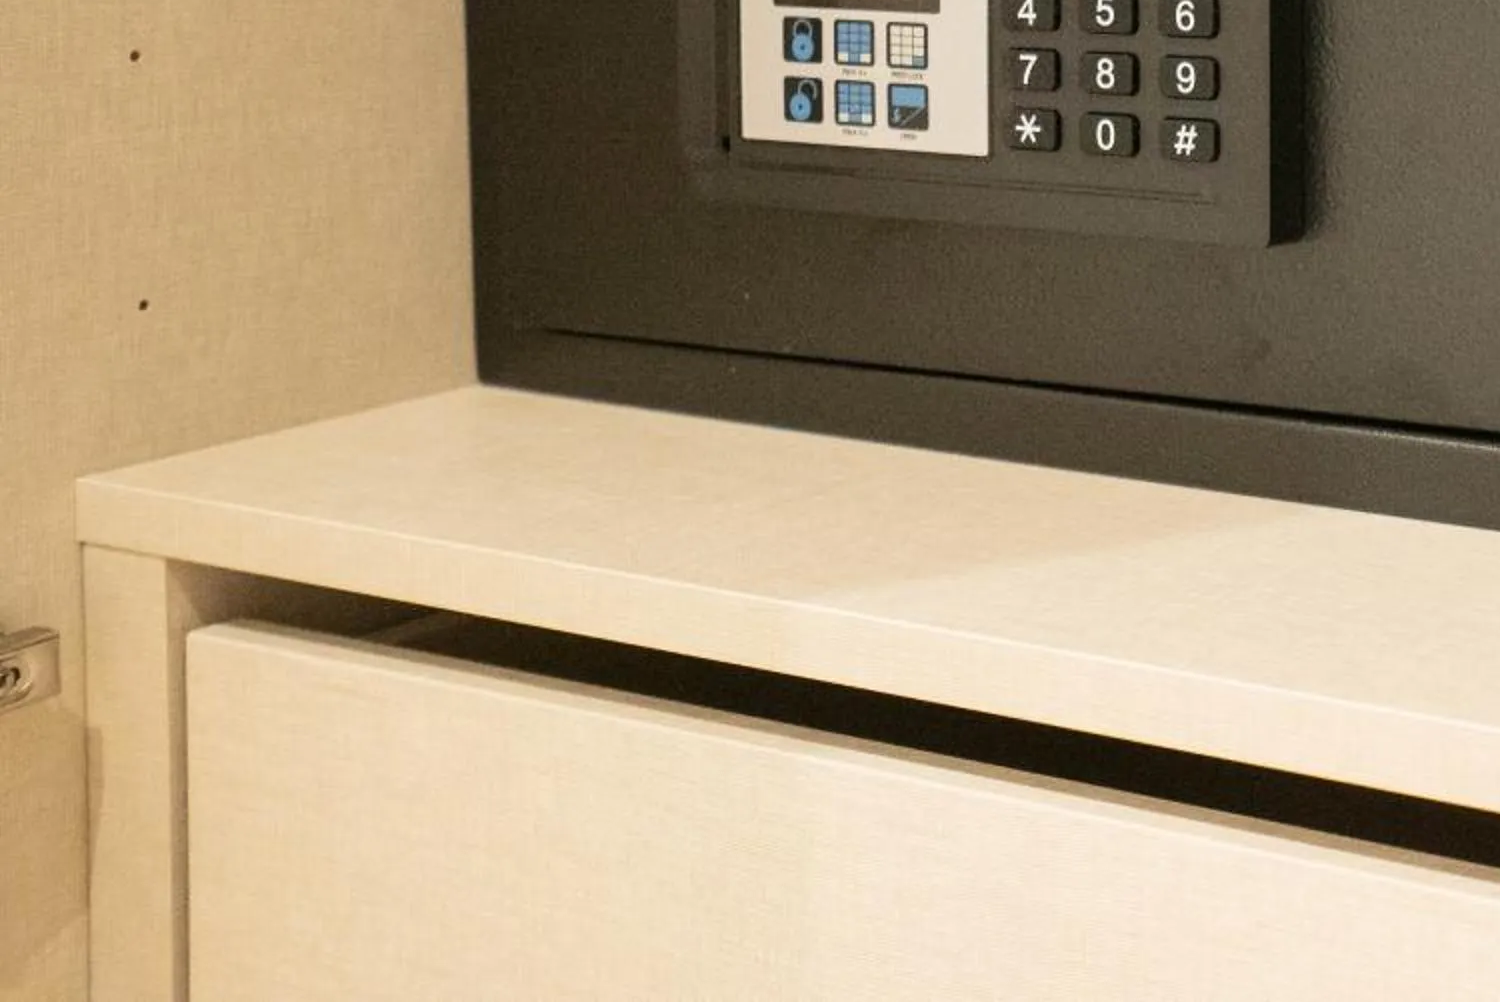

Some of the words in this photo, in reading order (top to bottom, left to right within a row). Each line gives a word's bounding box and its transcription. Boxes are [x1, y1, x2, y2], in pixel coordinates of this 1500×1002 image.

[1175, 0, 1195, 32] 6
[1019, 53, 1038, 85] 7
[1095, 57, 1115, 89] 8
[1176, 61, 1196, 94] 9
[1096, 118, 1115, 151] 0
[1173, 124, 1198, 156] #
